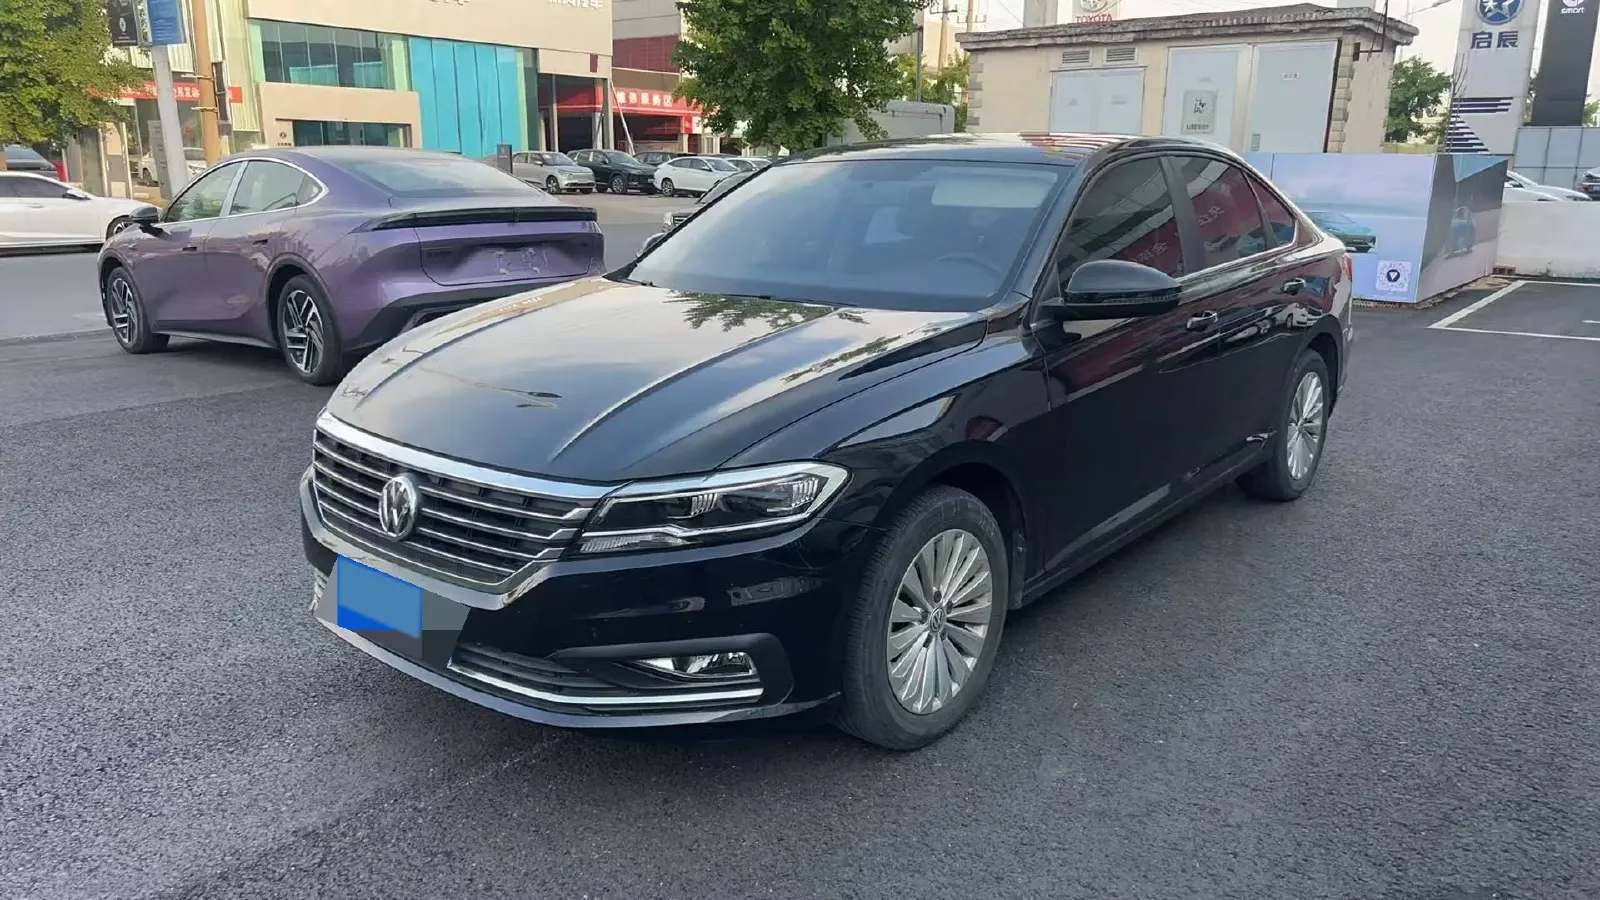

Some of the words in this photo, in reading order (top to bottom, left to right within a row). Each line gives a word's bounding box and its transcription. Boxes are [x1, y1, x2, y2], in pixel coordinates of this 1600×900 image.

[1076, 13, 1113, 24] TOYOTA
[1470, 31, 1519, 50] 启辰
[616, 90, 673, 108] 维修服务区
